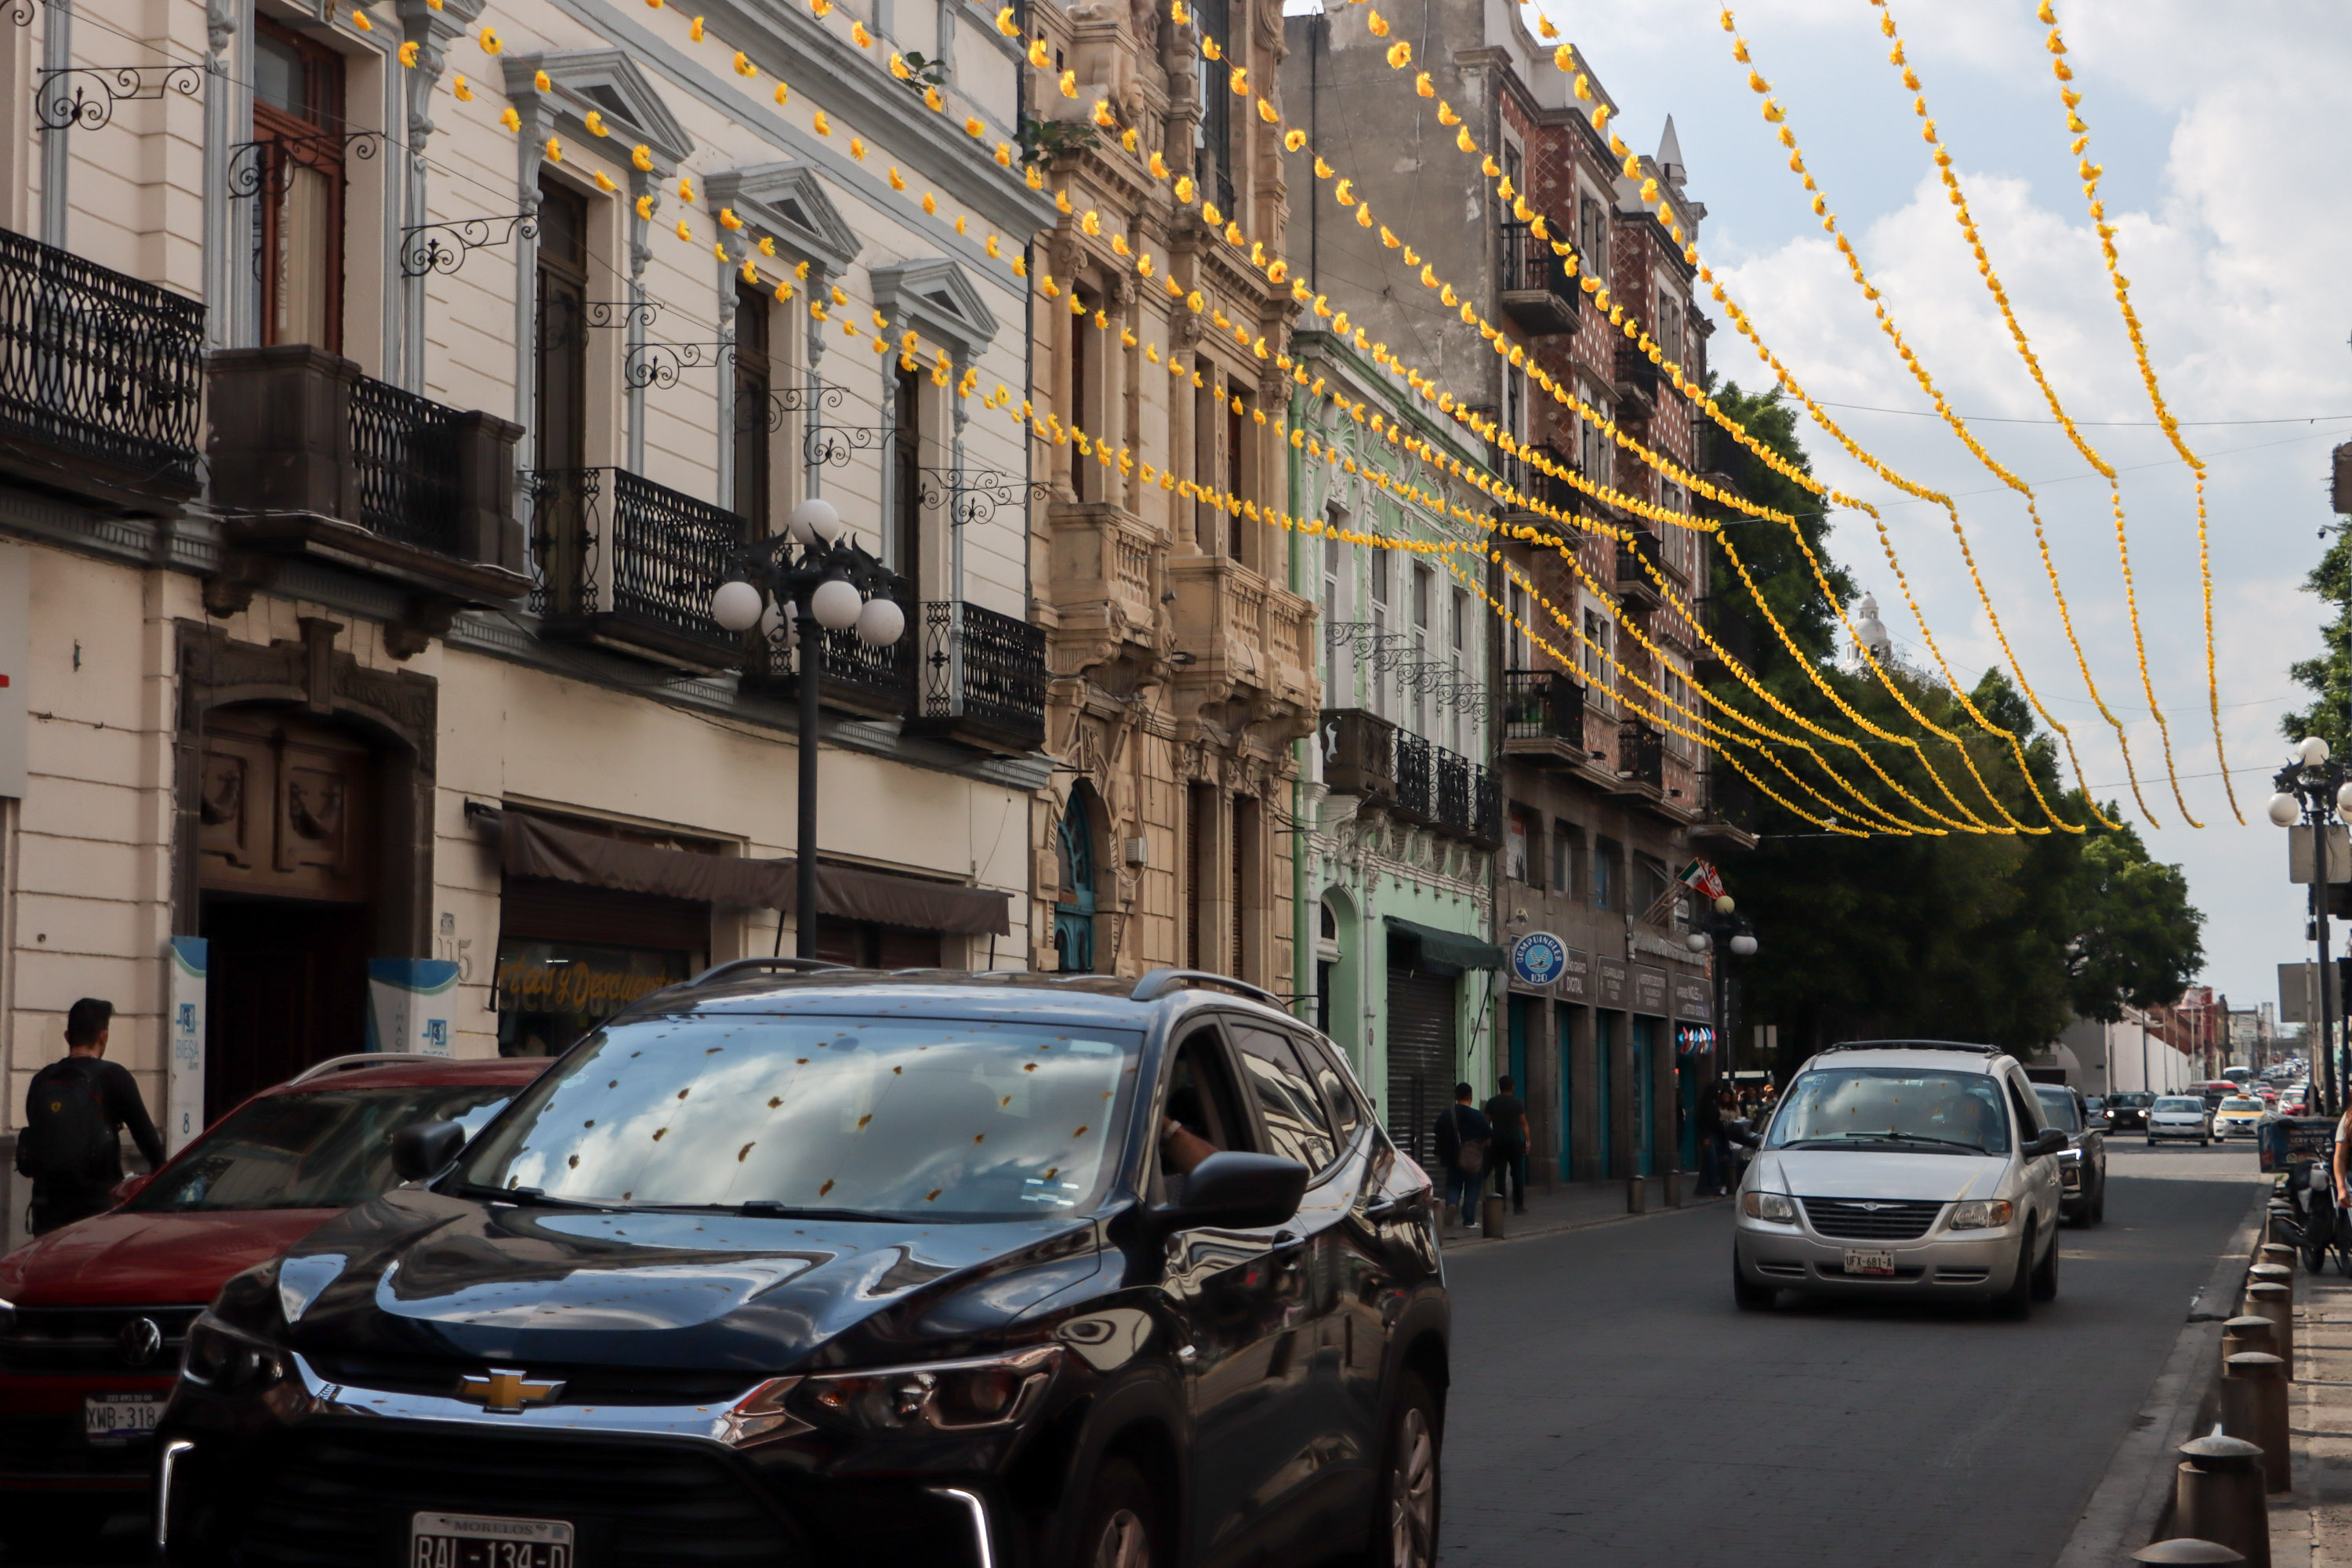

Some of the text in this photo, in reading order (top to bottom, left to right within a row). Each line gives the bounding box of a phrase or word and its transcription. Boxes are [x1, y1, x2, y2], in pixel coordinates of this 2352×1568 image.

[1516, 935, 1562, 963] COMPUINGLES
[1566, 976, 1583, 993] DIGITAL
[176, 1039, 199, 1059] BIESA
[183, 1112, 190, 1134] 8
[1846, 1255, 1892, 1268] UFX-681-A
[454, 1520, 533, 1535] MORELOS
